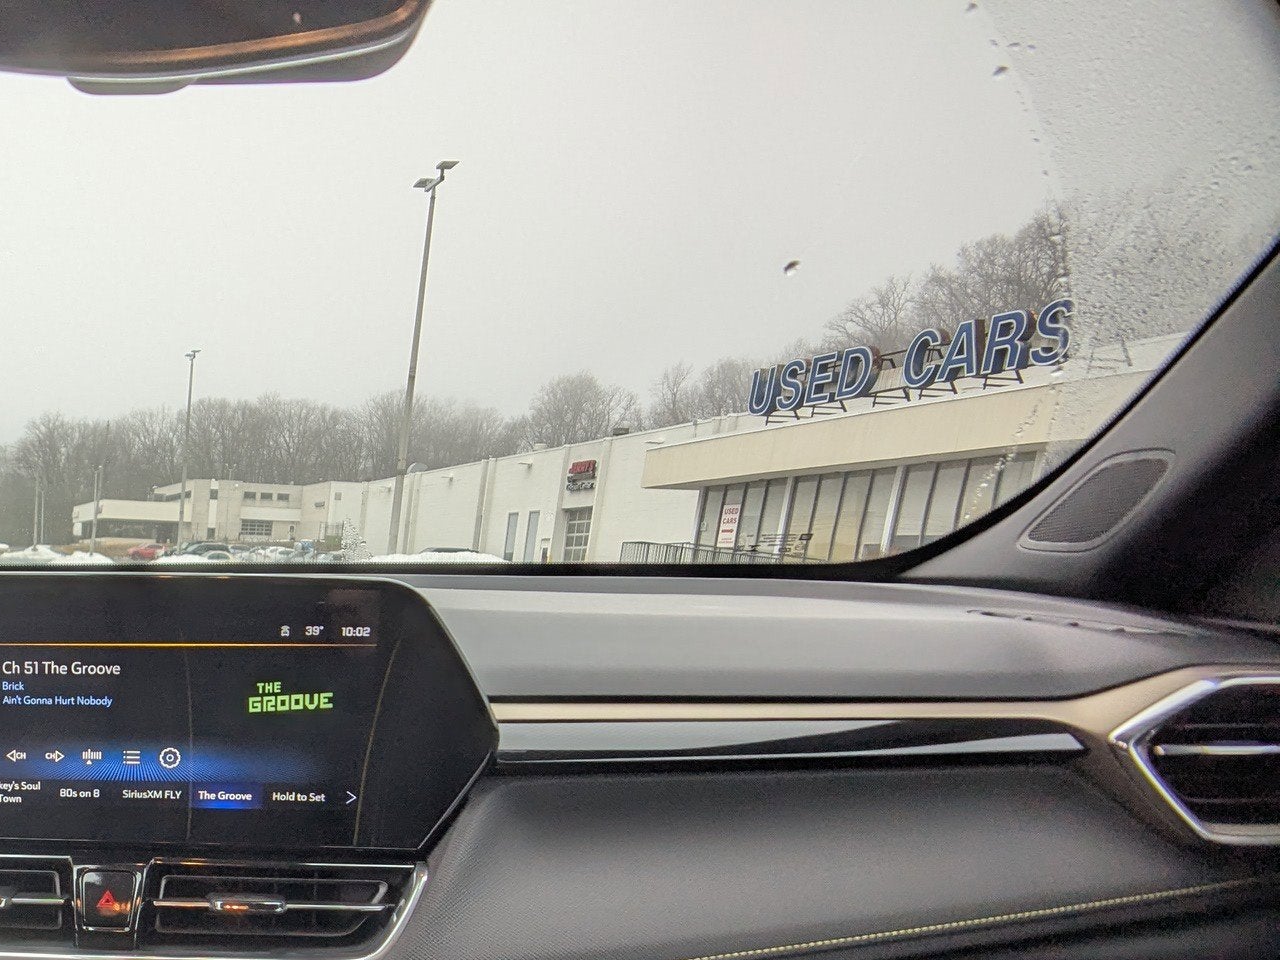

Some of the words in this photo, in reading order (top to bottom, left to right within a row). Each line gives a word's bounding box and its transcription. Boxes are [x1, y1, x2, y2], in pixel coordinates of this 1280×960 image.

[748, 346, 873, 415] USED
[902, 299, 1074, 388] CARS
[341, 626, 370, 637] 10:02
[2, 661, 20, 675] Ch
[24, 662, 39, 675] 51
[42, 662, 68, 675] The
[71, 662, 121, 675] Groove
[2, 682, 24, 691] Brick
[257, 682, 281, 694] THE
[2, 696, 21, 705] Ain't
[24, 696, 52, 705] Gonna
[55, 696, 74, 705] Hurt
[77, 696, 112, 707] Nobody
[248, 692, 333, 713] GROOVE
[21, 782, 41, 791] Soul
[60, 789, 77, 798] 80s
[93, 789, 100, 798] 8
[122, 790, 162, 799] SiriusXM
[164, 790, 182, 799] FLY
[198, 791, 217, 800] The
[218, 791, 252, 800] Groove
[272, 792, 295, 801] Hold
[309, 793, 325, 802] Set
